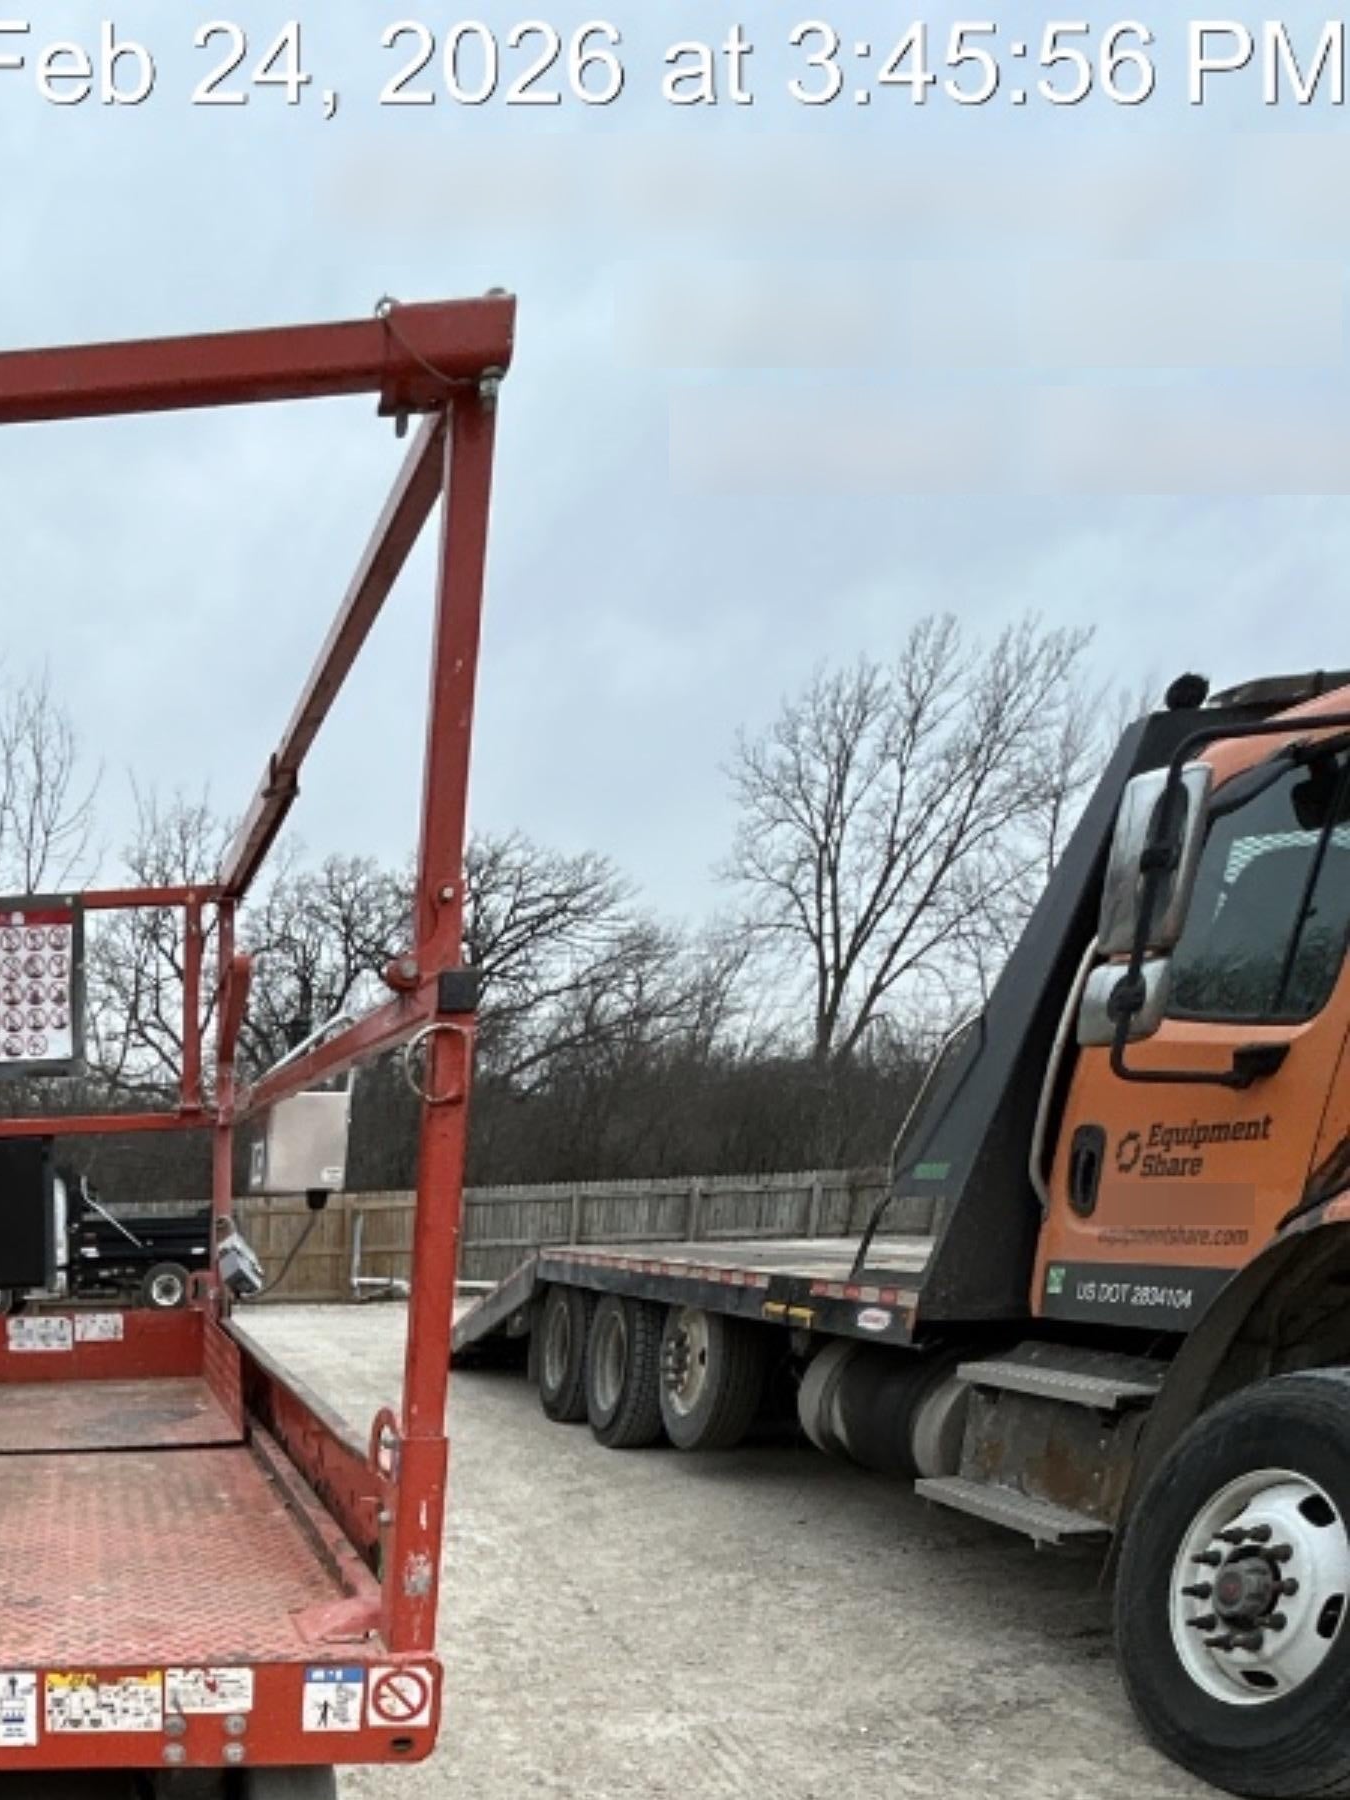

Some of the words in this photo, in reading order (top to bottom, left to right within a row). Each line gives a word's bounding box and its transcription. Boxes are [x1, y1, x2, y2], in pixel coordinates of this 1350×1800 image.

[1146, 1113, 1274, 1152] Equipment
[1139, 1153, 1205, 1177] Share
[1076, 1281, 1096, 1301] US
[1097, 1283, 1131, 1303] DOT
